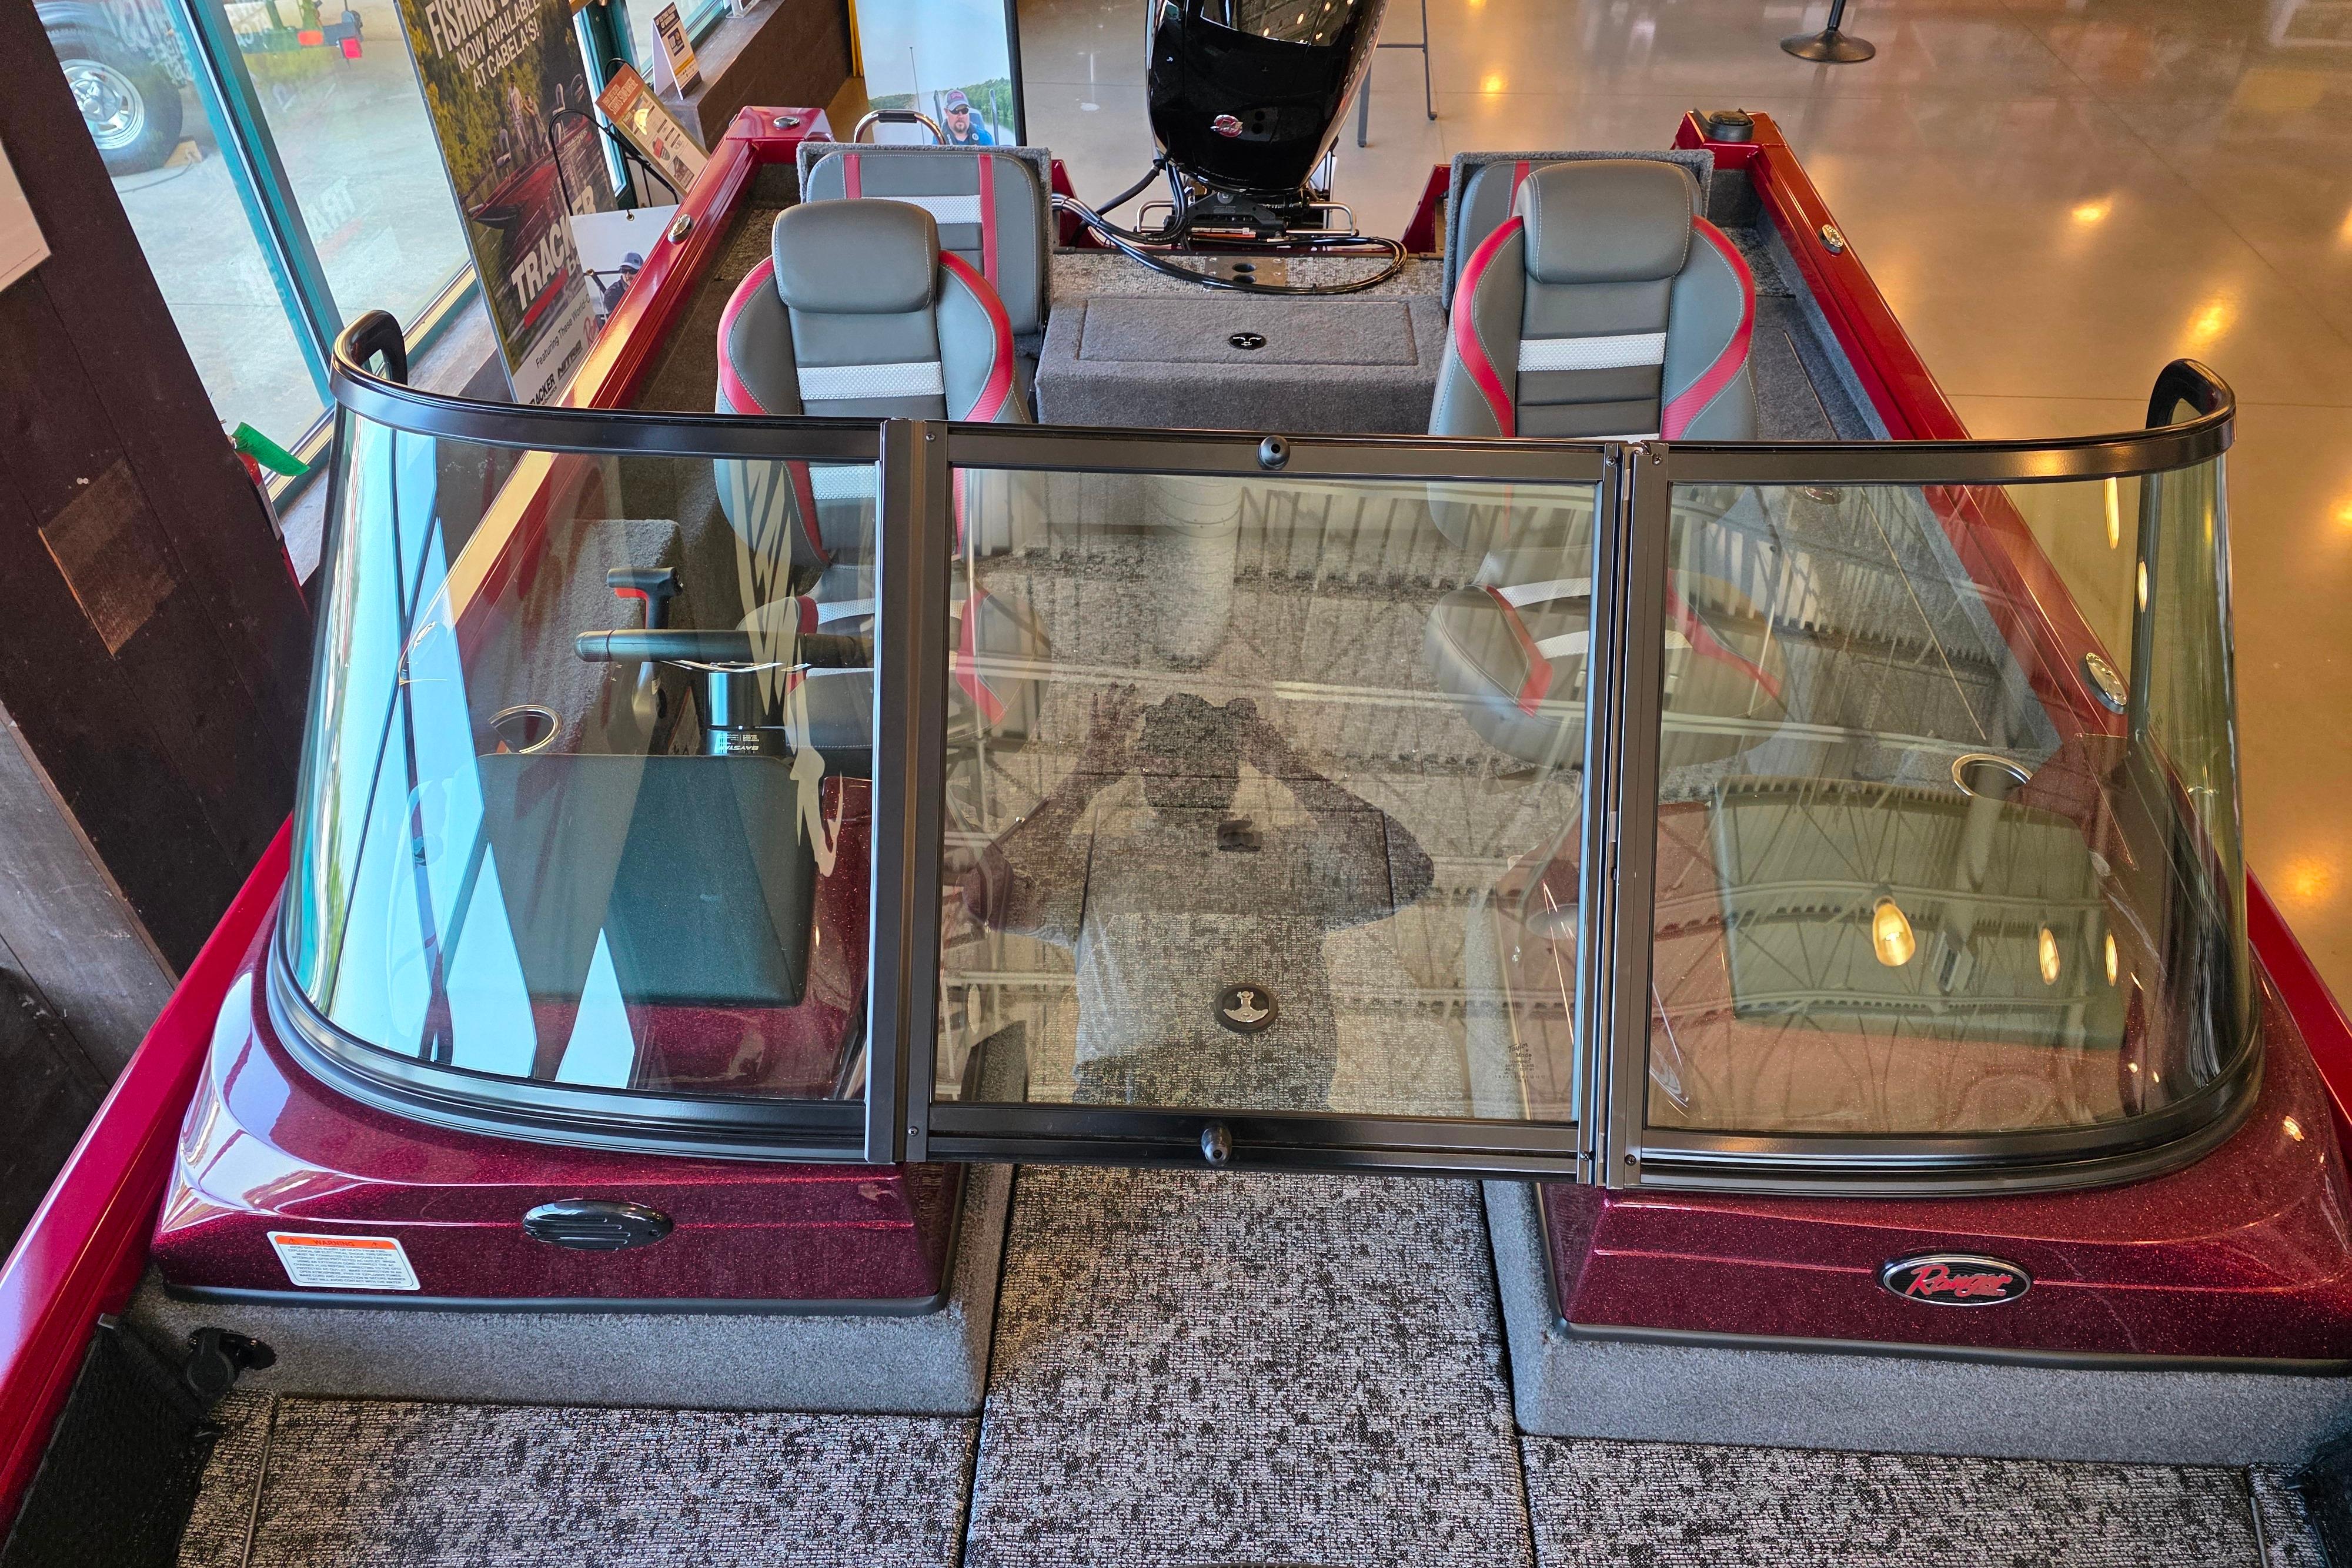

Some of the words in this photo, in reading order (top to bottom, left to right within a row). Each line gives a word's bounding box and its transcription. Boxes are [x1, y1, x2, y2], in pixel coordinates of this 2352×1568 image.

[456, 32, 486, 73] NOW
[473, 62, 487, 92] AT
[487, 16, 540, 78] CABELA'S!
[536, 336, 559, 369] Featuring
[557, 319, 573, 339] These
[571, 293, 590, 321] World-C
[529, 373, 555, 404] ACKER
[1508, 1042, 1528, 1053] Taylor
[1905, 1264, 2014, 1297] Ranger
